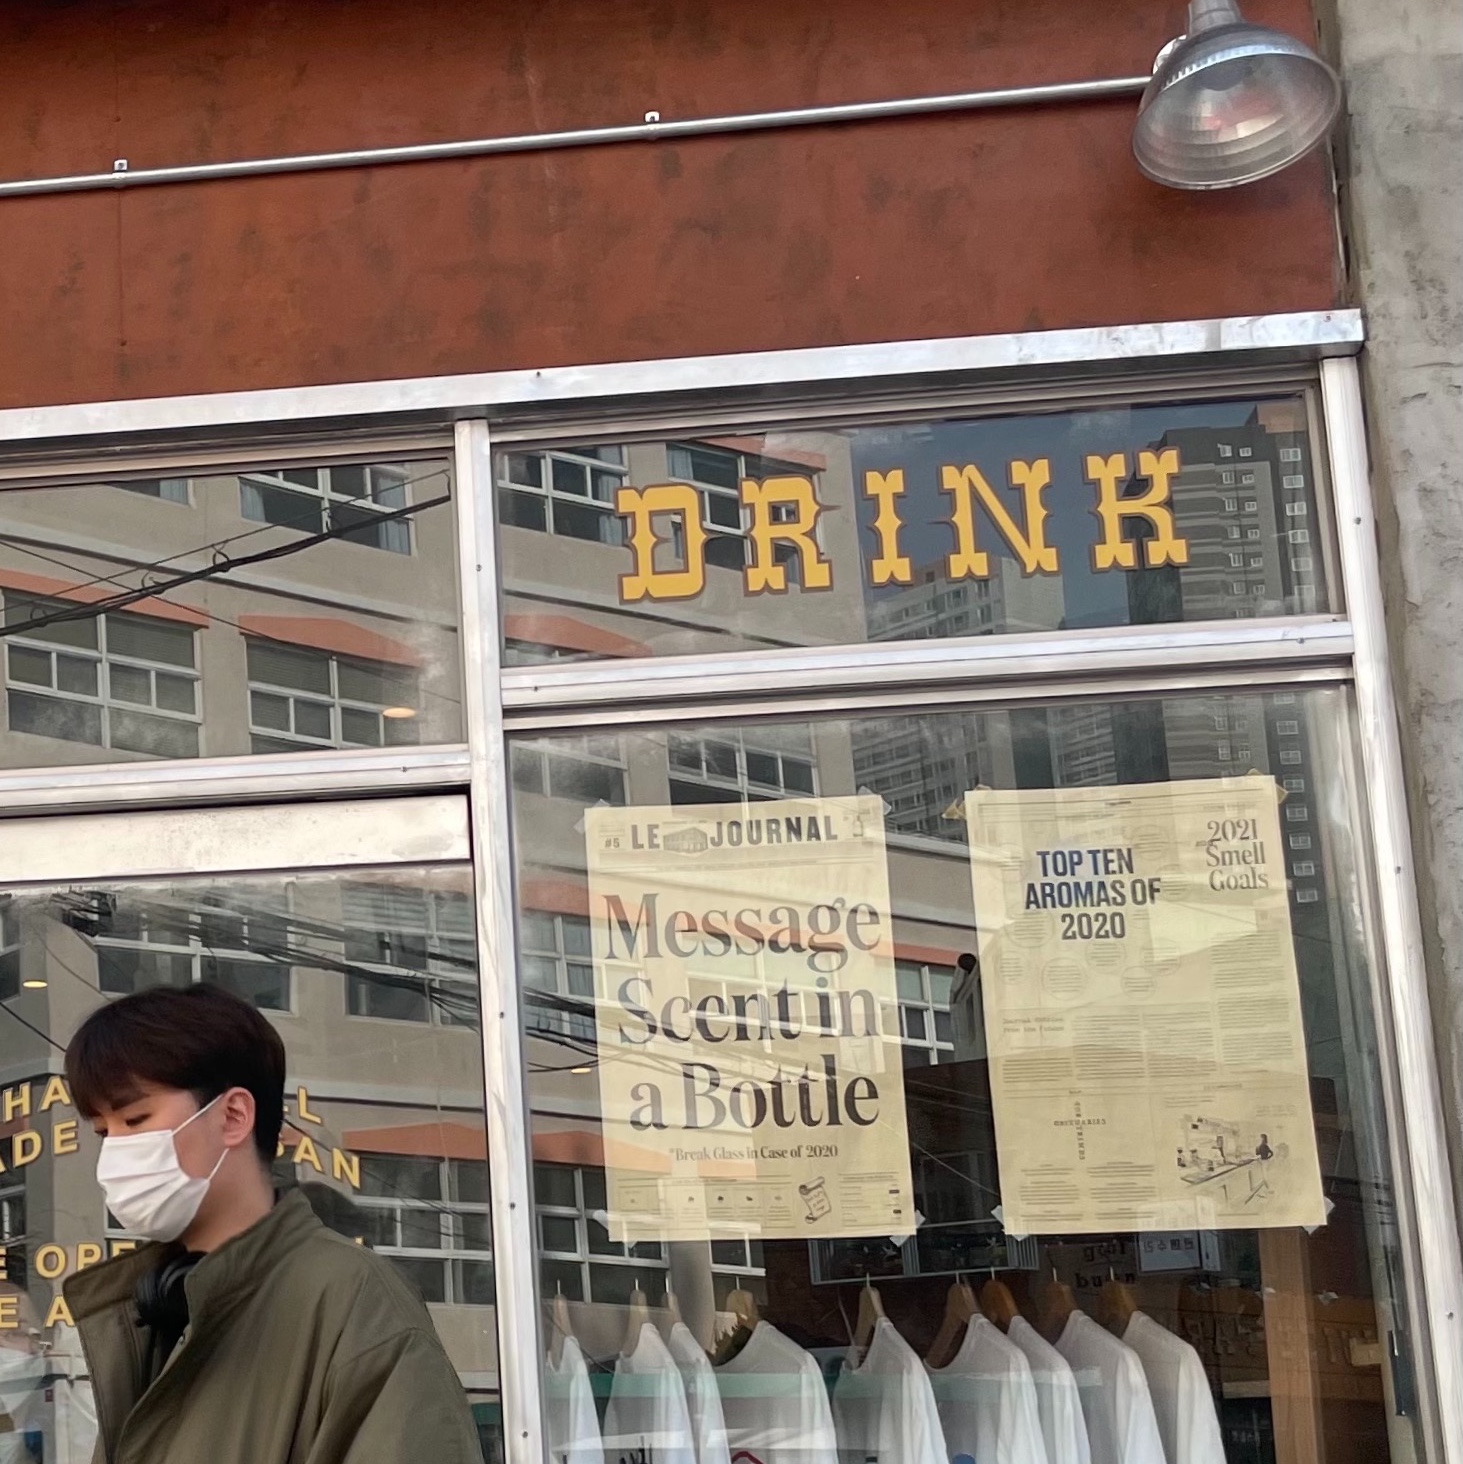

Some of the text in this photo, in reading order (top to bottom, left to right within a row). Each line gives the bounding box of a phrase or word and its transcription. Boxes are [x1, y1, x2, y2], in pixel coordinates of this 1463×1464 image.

[614, 446, 1190, 605] DRINK
[631, 816, 839, 849] LE JOURNAL
[1207, 818, 1258, 842] 2021
[1037, 848, 1134, 877] TOP TEN
[1206, 842, 1266, 867] Smell
[1025, 878, 1161, 909] AROMAS OF
[1209, 869, 1269, 892] Goals
[602, 893, 880, 973] Message
[1061, 912, 1126, 940] 2020
[618, 976, 879, 1044] Scent in
[629, 1054, 880, 1131] a Bottle
[713, 1147, 744, 1160] Glass
[760, 1147, 788, 1159] Case
[790, 1145, 802, 1158] of
[807, 1145, 838, 1158] 2020
